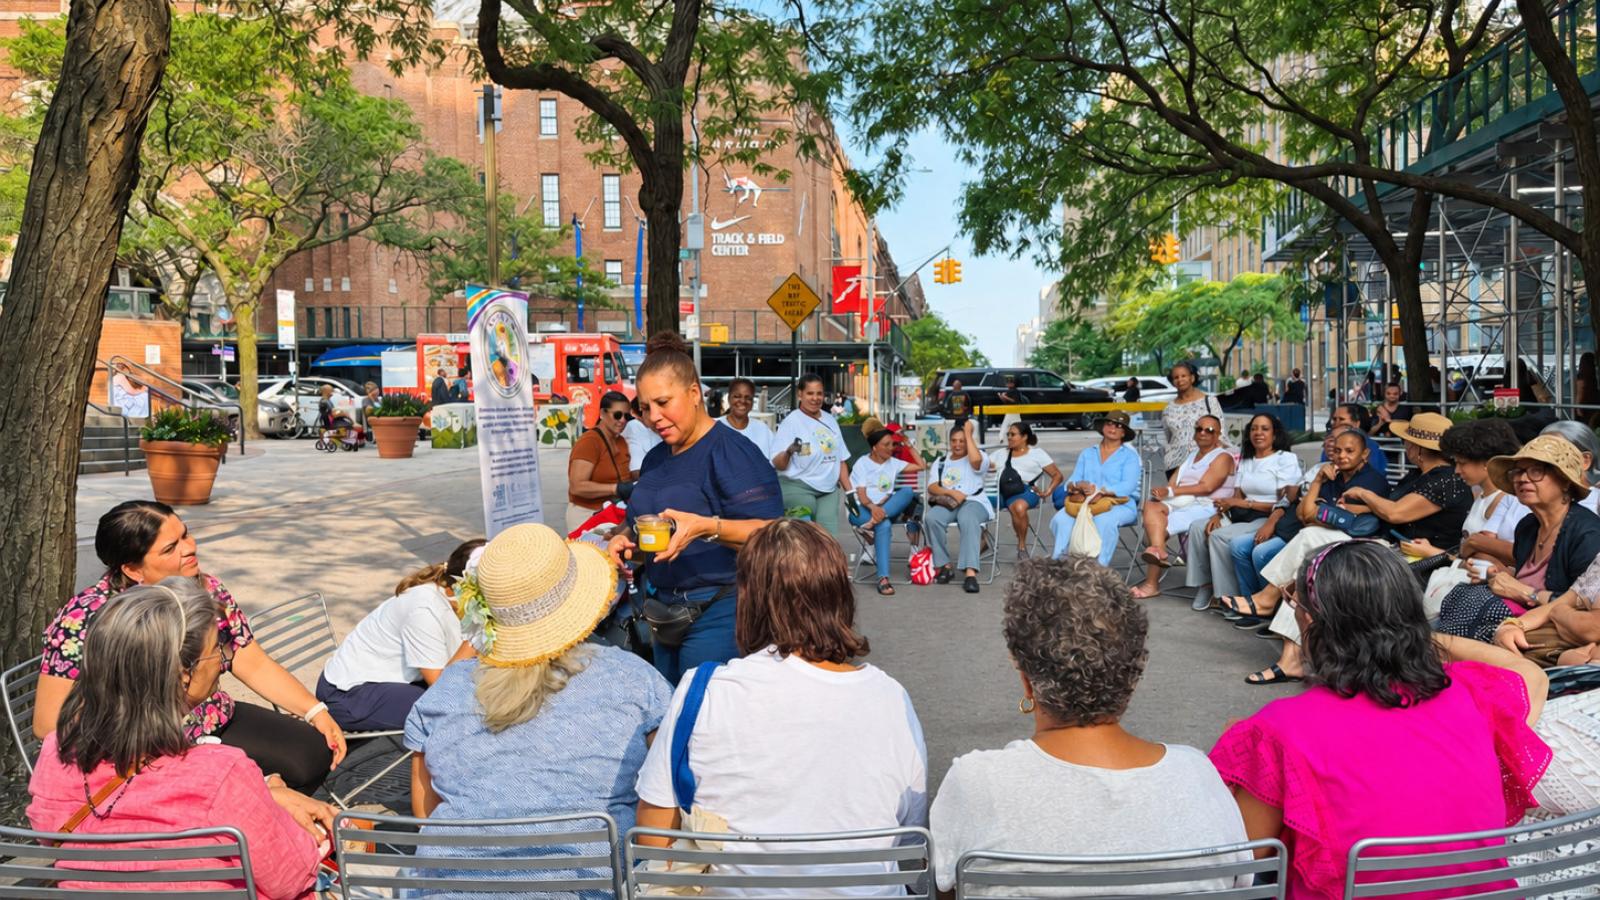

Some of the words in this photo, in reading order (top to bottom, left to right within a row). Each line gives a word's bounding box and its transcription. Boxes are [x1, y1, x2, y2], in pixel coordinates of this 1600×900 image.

[711, 232, 744, 244] TRACK
[746, 233, 755, 244] &
[758, 233, 785, 244] FIELD
[711, 244, 749, 256] CENTER
